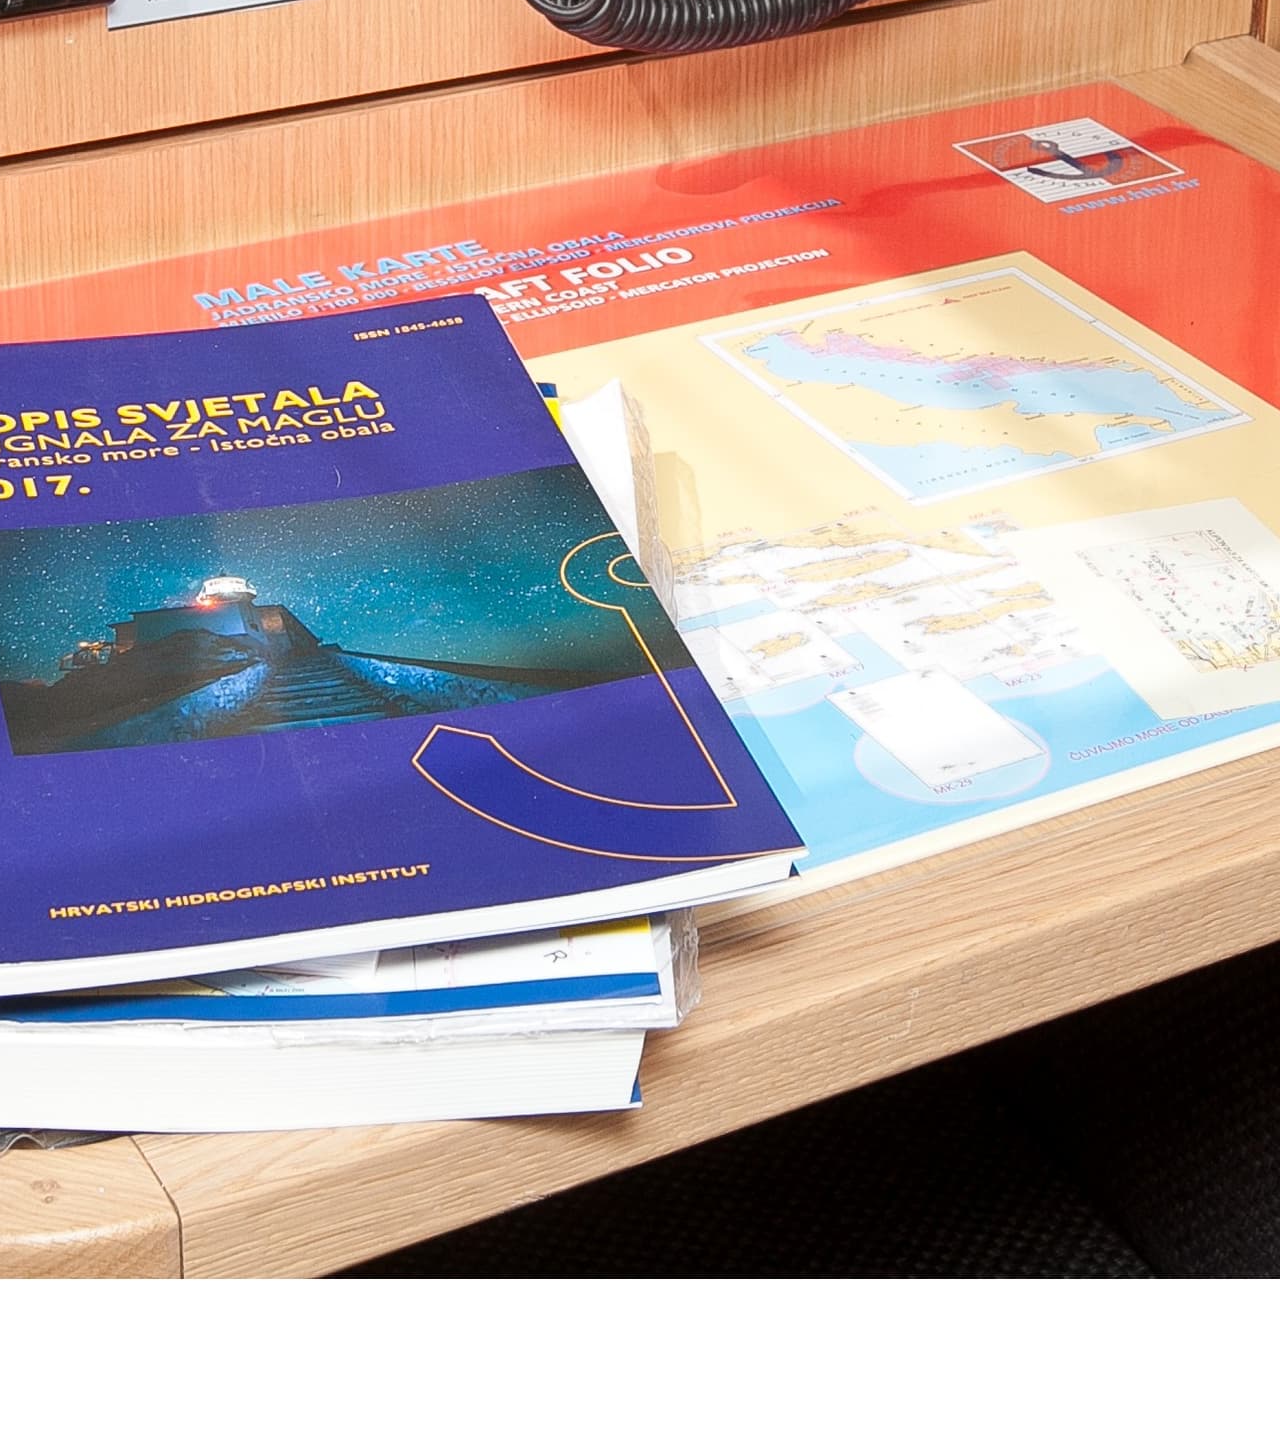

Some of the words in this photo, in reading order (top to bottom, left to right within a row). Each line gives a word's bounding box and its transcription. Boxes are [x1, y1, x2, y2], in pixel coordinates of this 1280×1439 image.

[365, 289, 398, 302] 000
[414, 267, 504, 291] BESSELOV
[511, 247, 591, 272] ELIPSOID
[604, 218, 738, 252] MERCATOROVA
[741, 198, 841, 224] PROJEKCIJA
[561, 246, 694, 285] FOLIO
[194, 271, 333, 310] MALE
[338, 240, 488, 280] KARTE
[211, 286, 354, 320] JADRANSKO
[358, 271, 425, 291] MORE
[445, 246, 544, 274] ISTOČNA
[547, 231, 625, 252] OBALA
[510, 295, 605, 322] ELLIPSOID
[620, 271, 720, 299] MERCATOR
[720, 248, 829, 277] PROJECTION
[545, 280, 620, 302] COAST
[353, 328, 390, 341] ISSN
[118, 381, 381, 425] SVJETALA
[167, 421, 228, 441] ZA
[238, 401, 386, 433] MAGLU
[103, 445, 179, 462] more
[211, 431, 312, 452] Istočna
[321, 420, 395, 440] obala
[1136, 721, 1178, 742] MORE
[50, 899, 160, 919] HRVATSKI
[166, 878, 326, 908] HIDROGRAFSKI
[332, 864, 431, 887] INSTITUT
